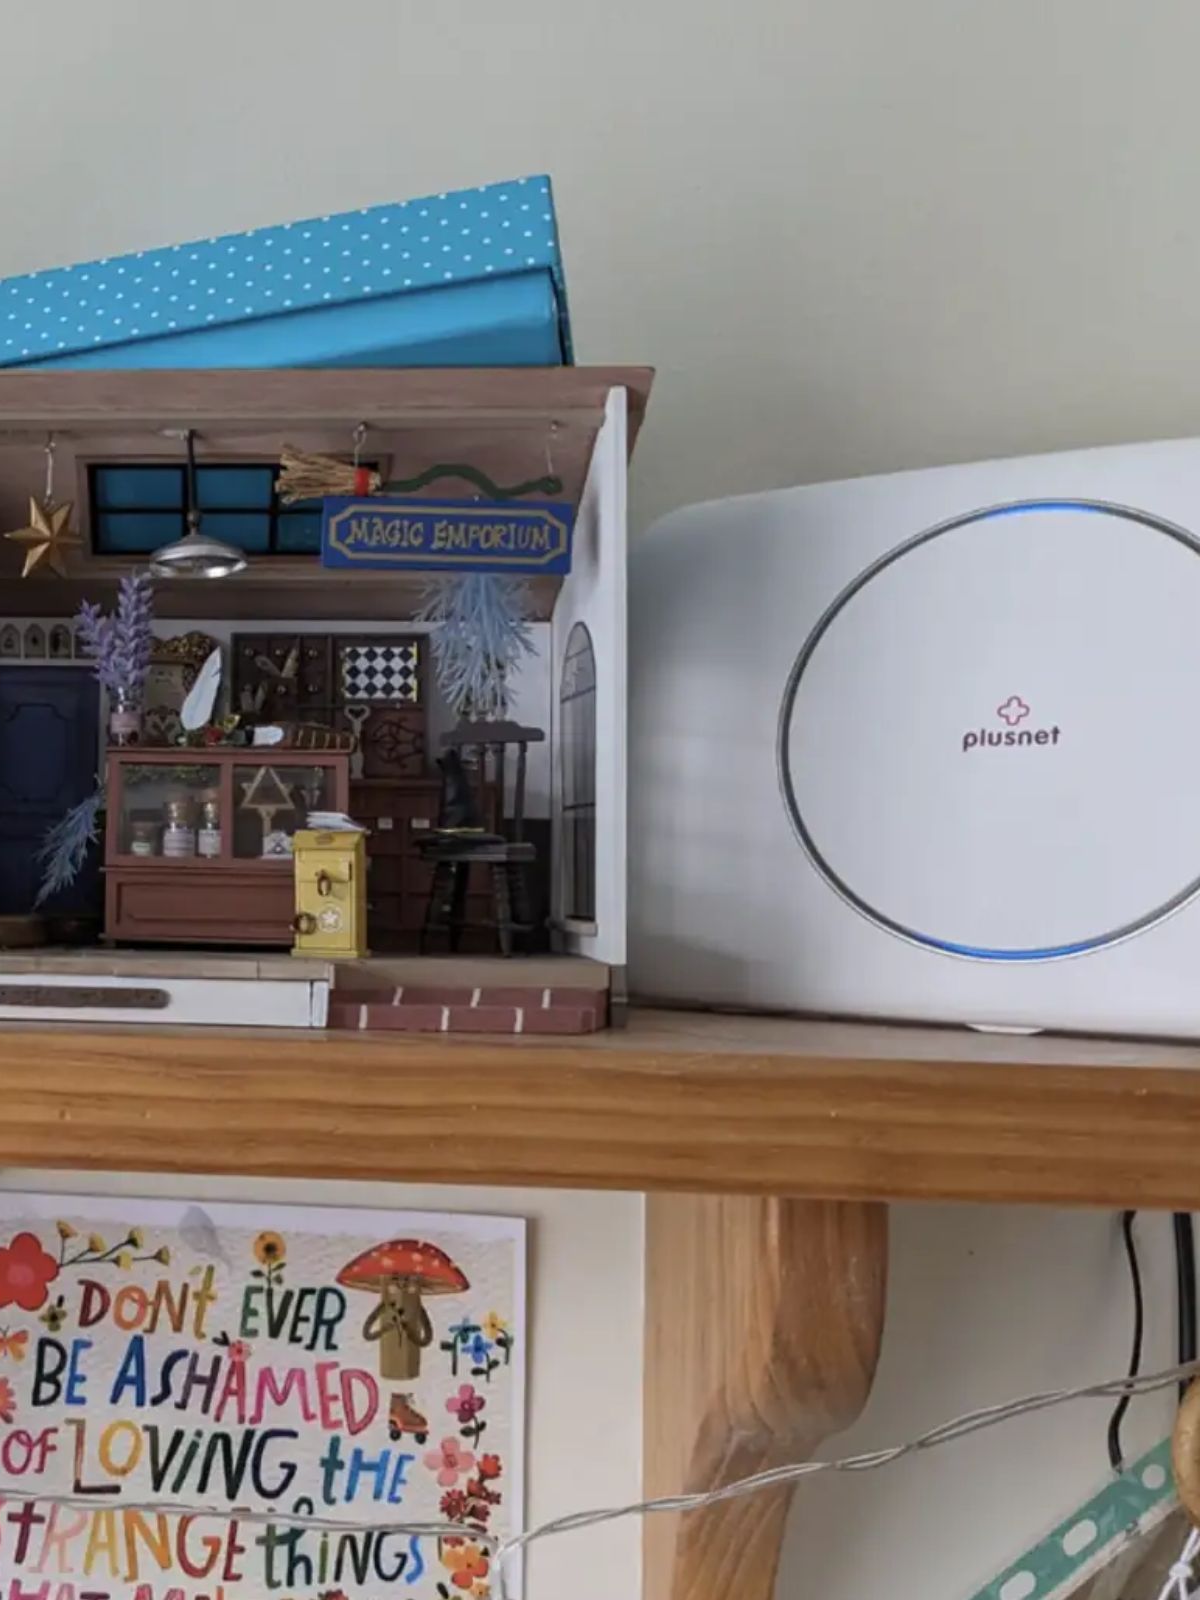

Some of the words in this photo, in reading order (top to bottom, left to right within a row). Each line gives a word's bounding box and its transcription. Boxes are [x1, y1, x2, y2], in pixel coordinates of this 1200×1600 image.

[346, 516, 424, 547] MAGIC
[430, 519, 552, 551] EMPORIUM
[962, 725, 1061, 752] plusnet
[240, 1285, 347, 1351] EVER
[32, 1338, 93, 1407] BE
[110, 1334, 380, 1436] ASHAMED
[2, 1427, 59, 1475] OF
